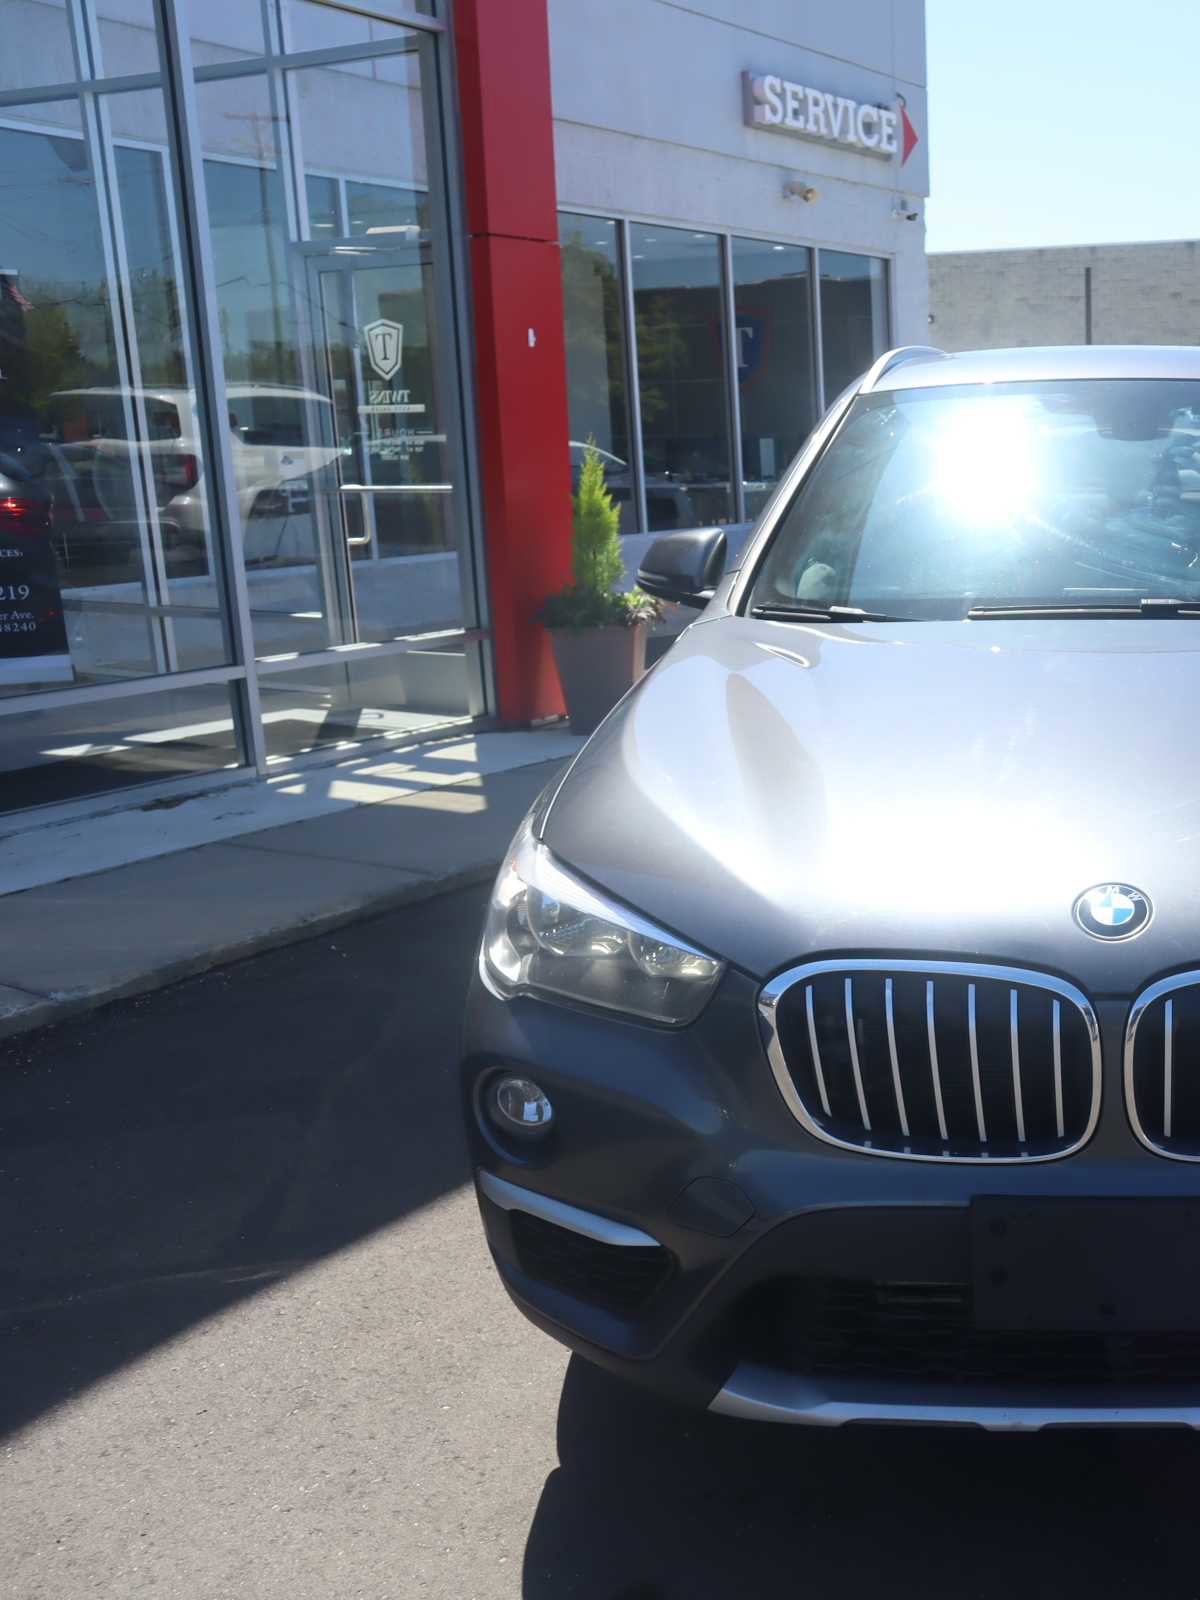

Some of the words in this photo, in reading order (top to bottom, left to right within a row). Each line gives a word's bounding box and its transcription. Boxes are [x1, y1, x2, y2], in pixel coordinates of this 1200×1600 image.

[764, 74, 897, 153] SERVICE
[375, 332, 393, 360] T
[11, 611, 34, 620] Ave.
